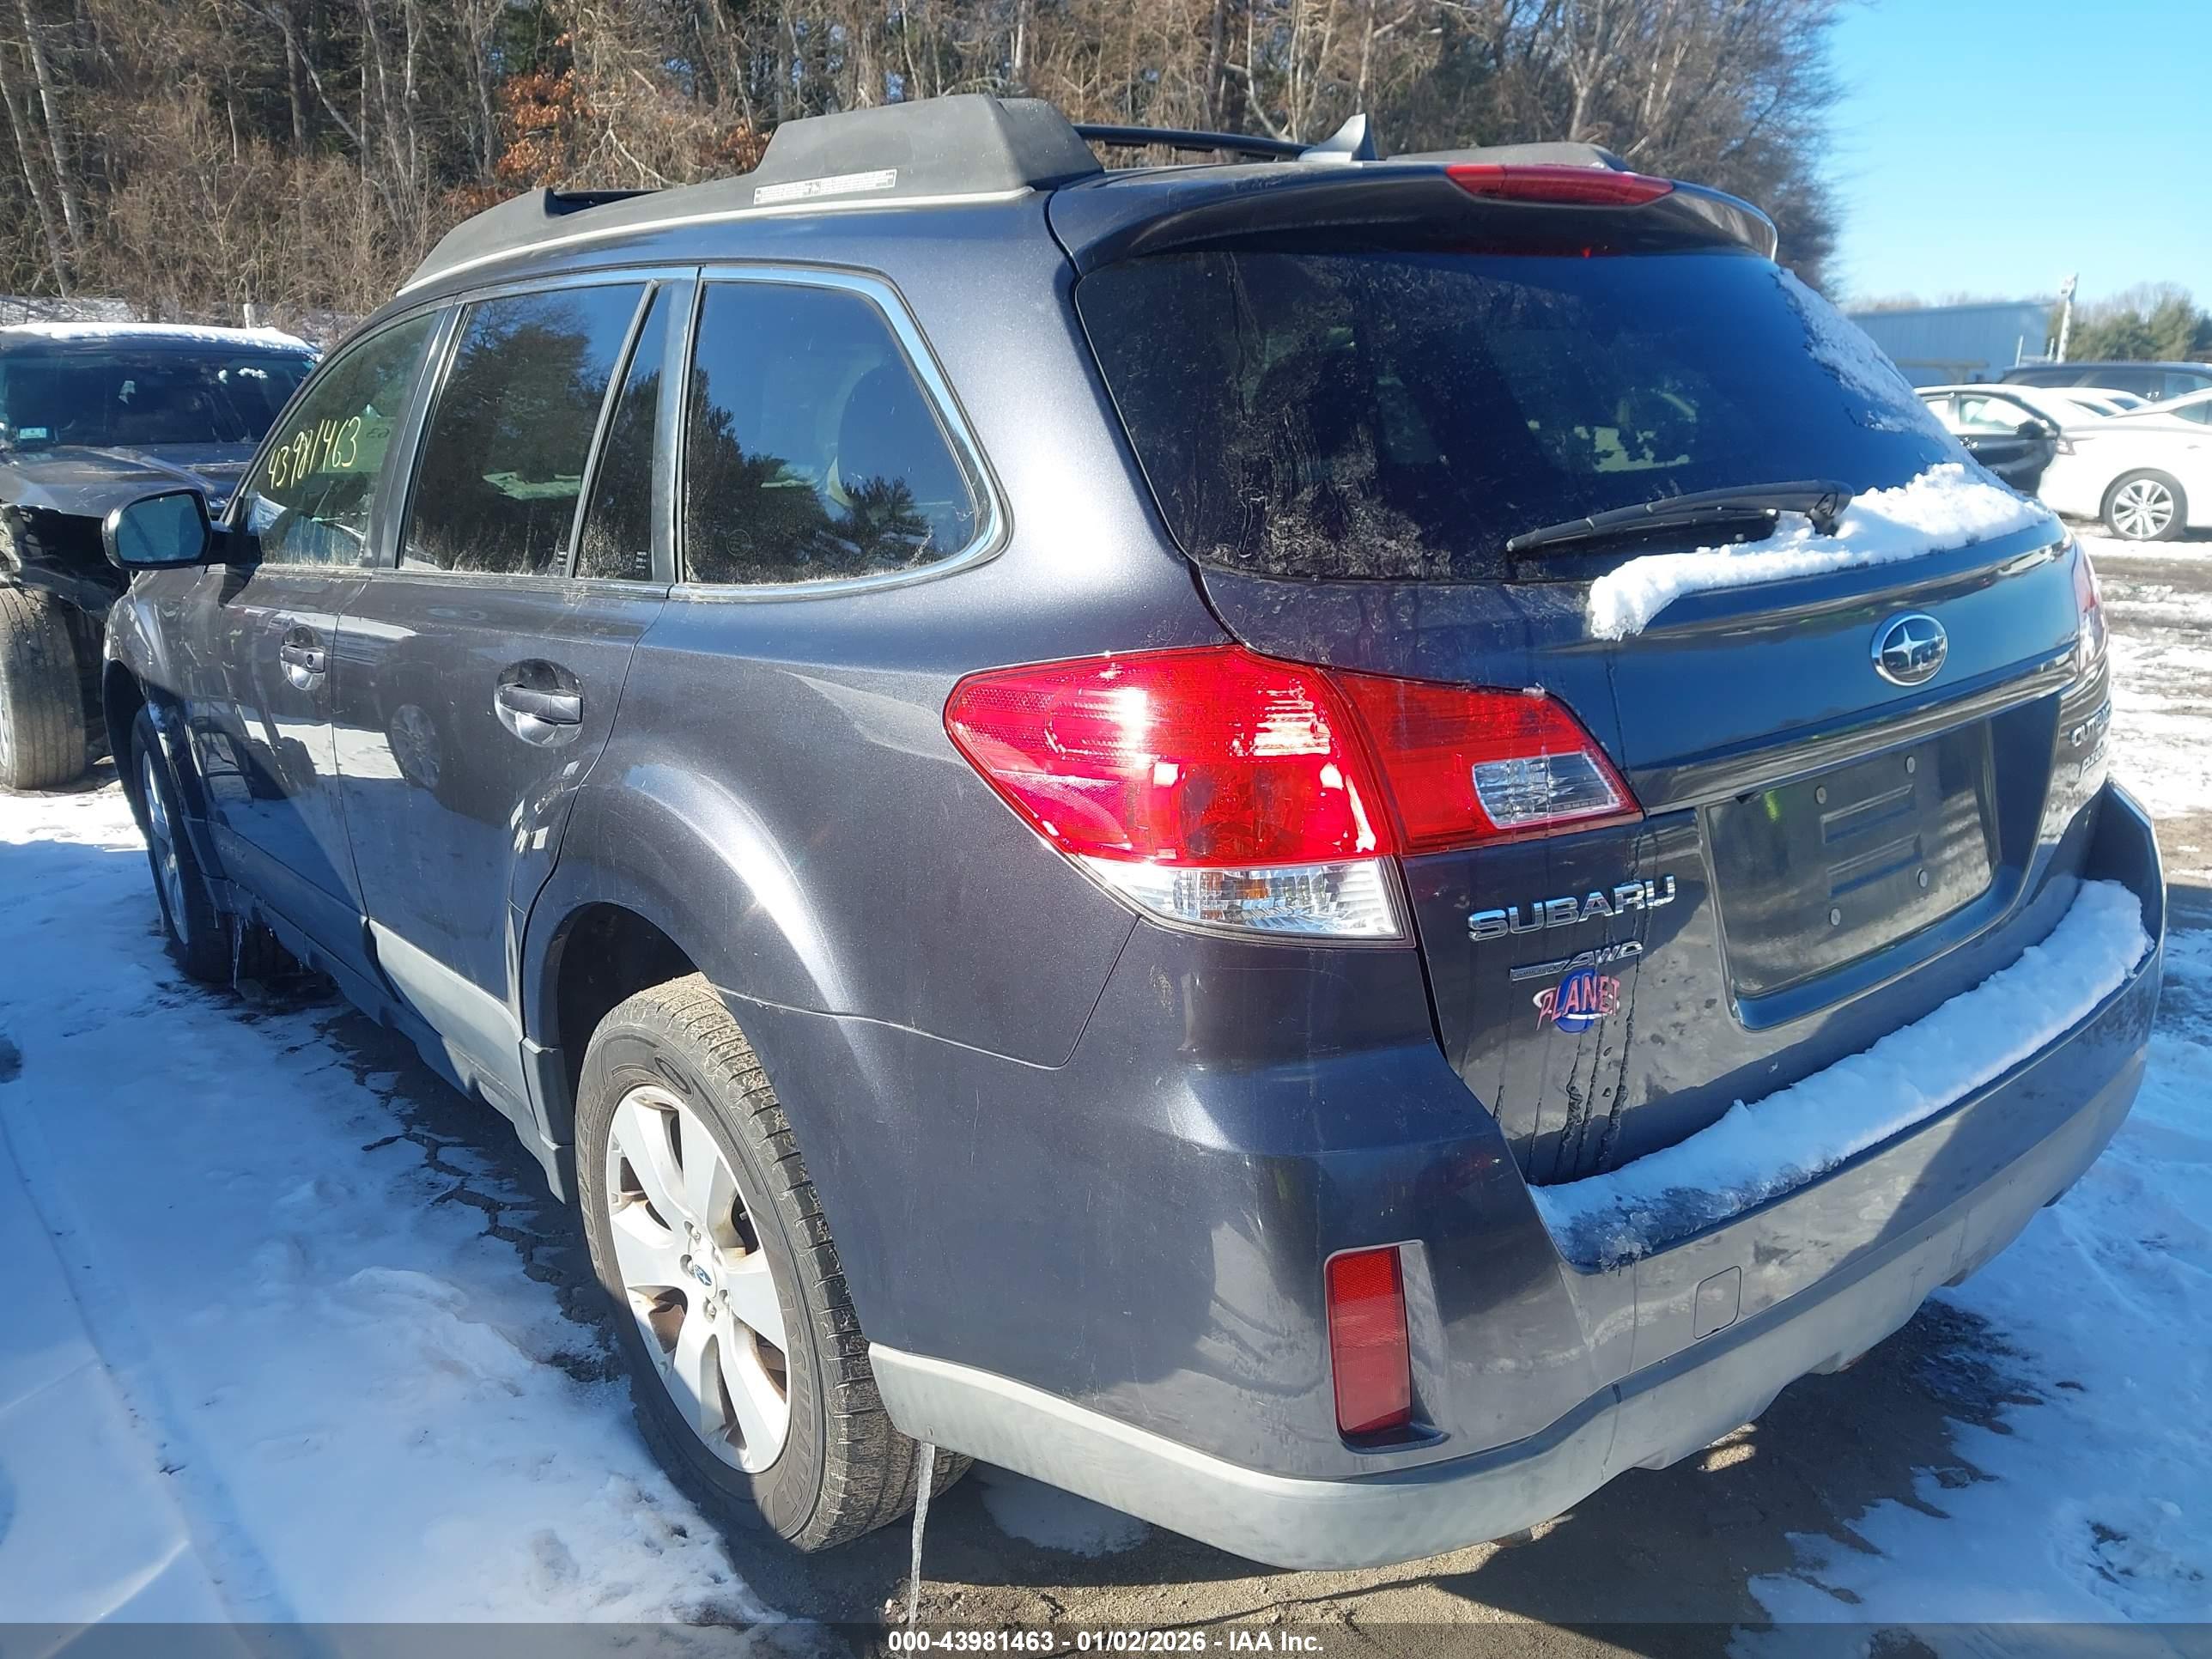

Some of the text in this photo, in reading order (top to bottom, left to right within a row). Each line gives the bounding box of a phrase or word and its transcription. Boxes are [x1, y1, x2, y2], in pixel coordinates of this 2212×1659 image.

[268, 416, 362, 490] 43981463
[1468, 875, 1675, 941] SUBARU
[1565, 940, 1643, 971] AWD
[1536, 975, 1620, 1030] PLANET
